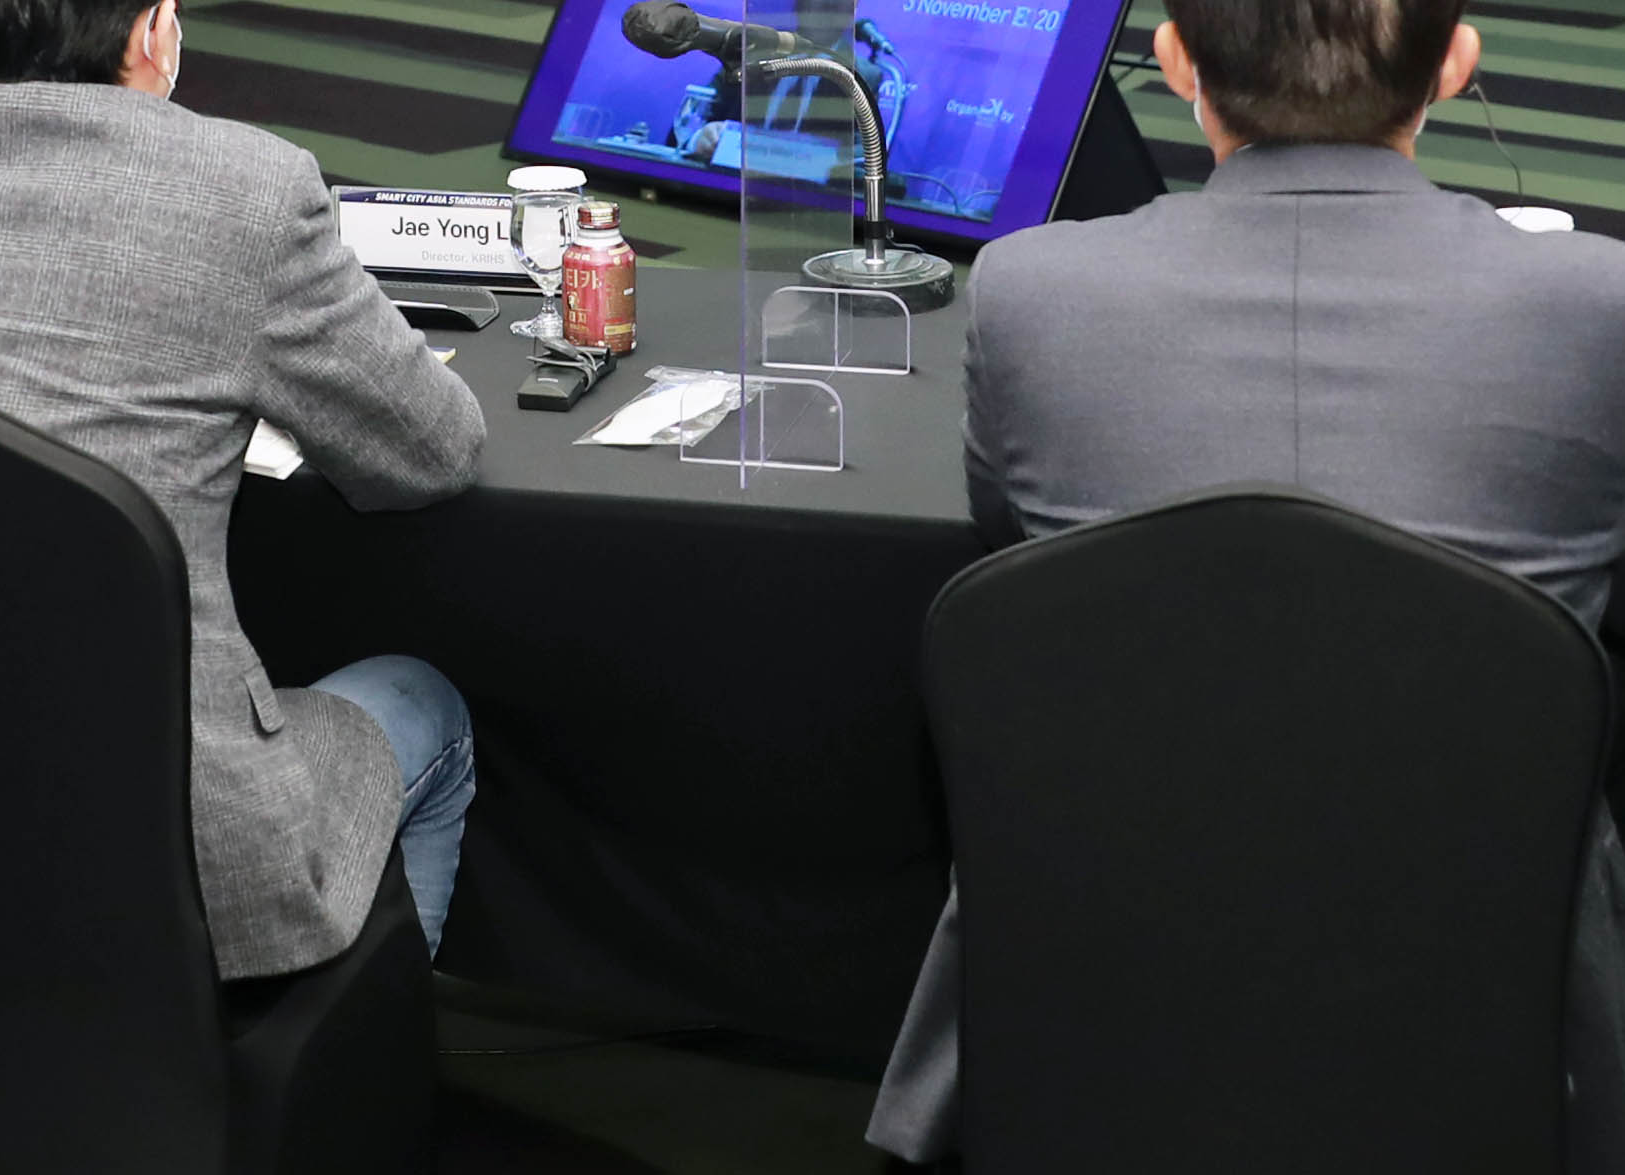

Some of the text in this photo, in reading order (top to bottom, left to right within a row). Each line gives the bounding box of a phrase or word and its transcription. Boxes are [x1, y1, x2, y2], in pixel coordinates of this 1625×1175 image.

[1034, 10, 1060, 31] 20
[375, 192, 406, 202] SMART
[406, 194, 427, 203] CITY
[426, 195, 448, 204] ASIA
[448, 196, 498, 207] STANDARDS
[392, 216, 430, 236] Jae
[437, 218, 489, 245] Yong
[471, 253, 504, 265] KRIHS
